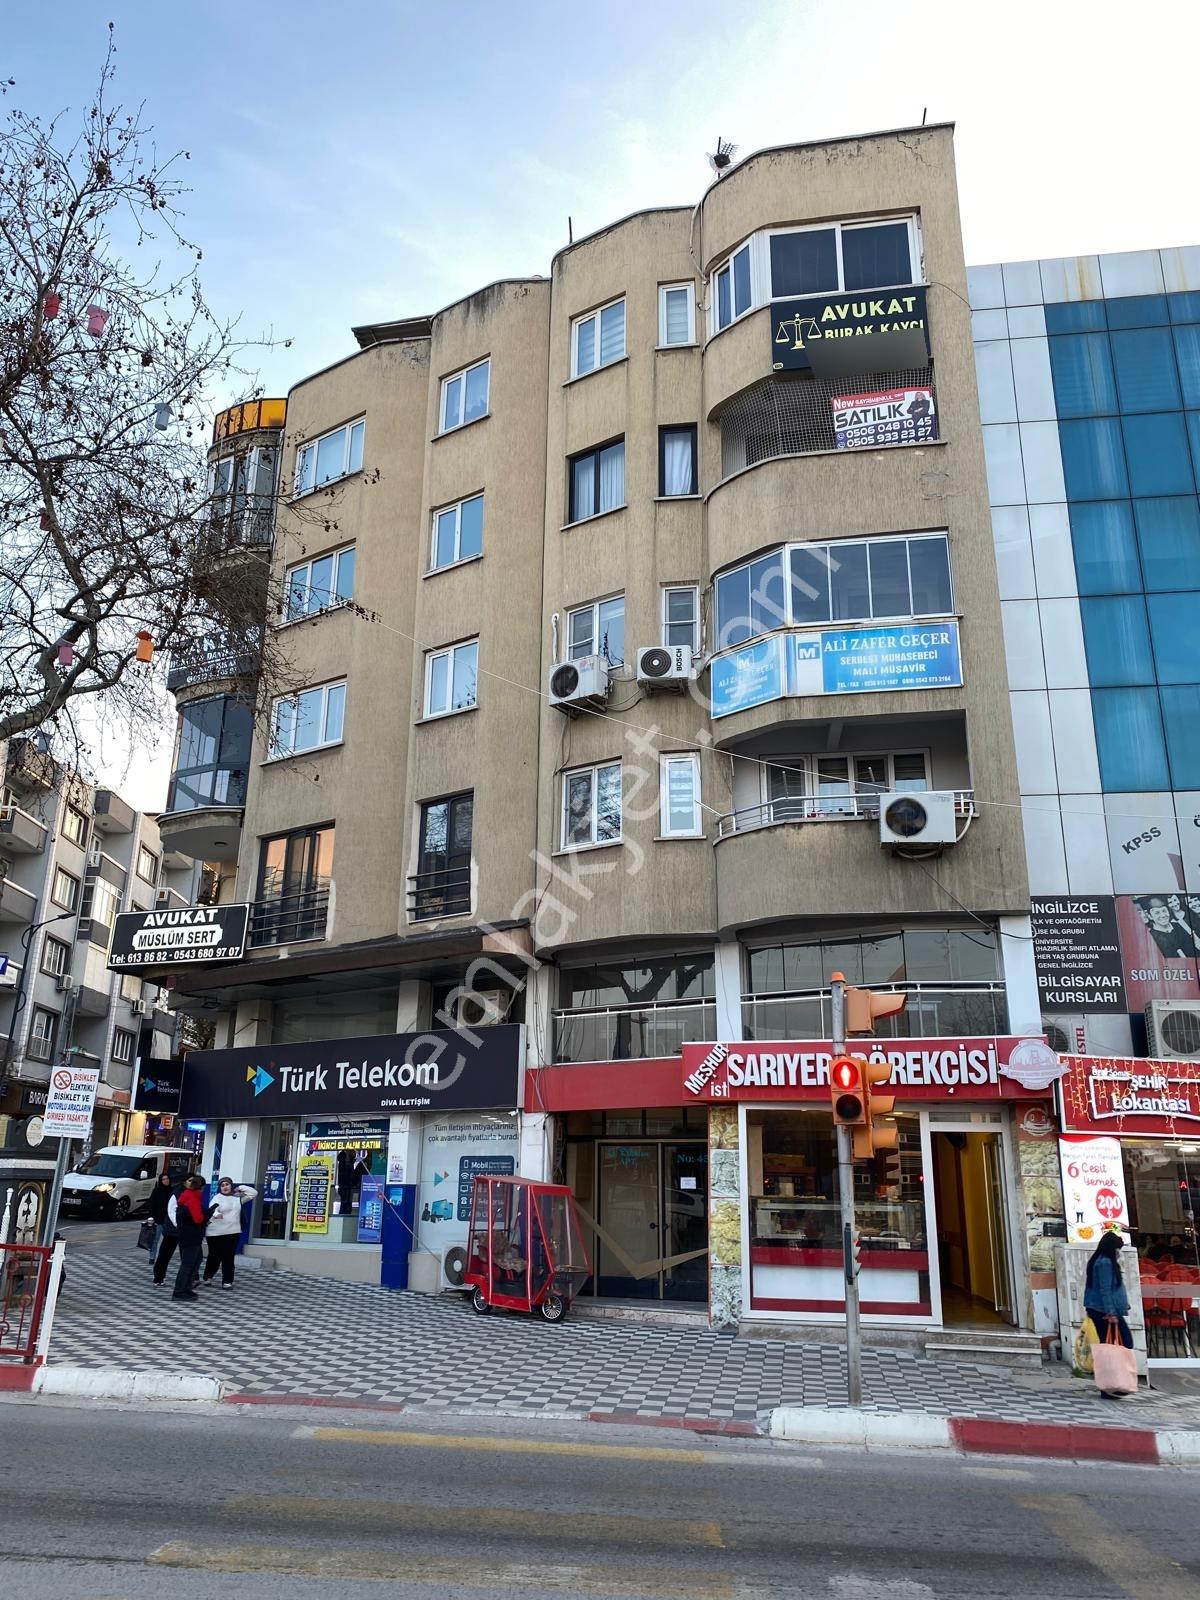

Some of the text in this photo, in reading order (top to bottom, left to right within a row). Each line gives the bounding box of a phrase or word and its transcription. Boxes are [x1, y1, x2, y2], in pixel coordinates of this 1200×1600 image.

[821, 296, 916, 322] AVUKAT
[834, 399, 854, 411] New
[836, 403, 905, 429] SATILIK
[846, 416, 932, 438] 0506 048 10 45
[846, 436, 875, 448] 0505
[877, 431, 899, 443] 933
[901, 428, 916, 438] 23
[918, 426, 932, 436] 27
[824, 632, 951, 652] ALİ ZAFER GEÇER
[1121, 826, 1162, 854] KPSS
[1031, 900, 1099, 914] İNGİLİZCE
[143, 908, 218, 927] AVUKAT
[138, 930, 216, 948] MÜSLÜM SERT
[111, 953, 126, 964] Tel:
[127, 952, 142, 963] 613
[144, 951, 155, 962] 86
[156, 951, 167, 961] 82
[174, 949, 196, 960] 0543
[197, 948, 214, 958] 680
[216, 947, 226, 957] 97
[228, 946, 240, 956] 07
[1053, 953, 1065, 961] YAŞ
[1039, 974, 1121, 987] BİLGİSAYAR
[1131, 969, 1159, 981] SOM
[1163, 966, 1194, 981] ÖZEL
[1046, 991, 1118, 1003] KURSLARI
[279, 1058, 439, 1093] Türk Telekom
[684, 1043, 730, 1095] MEŞHUR
[727, 1053, 832, 1087] SARIYER
[711, 1081, 728, 1097] ist
[1131, 1073, 1168, 1091] ŞEHİR
[54, 1091, 90, 1102] BİSİKLET VE
[381, 1097, 431, 1107] DİVA İLETİŞİM
[1111, 1092, 1191, 1112] Lokantası
[1067, 1162, 1079, 1178] 6
[1098, 1194, 1121, 1210] 200
